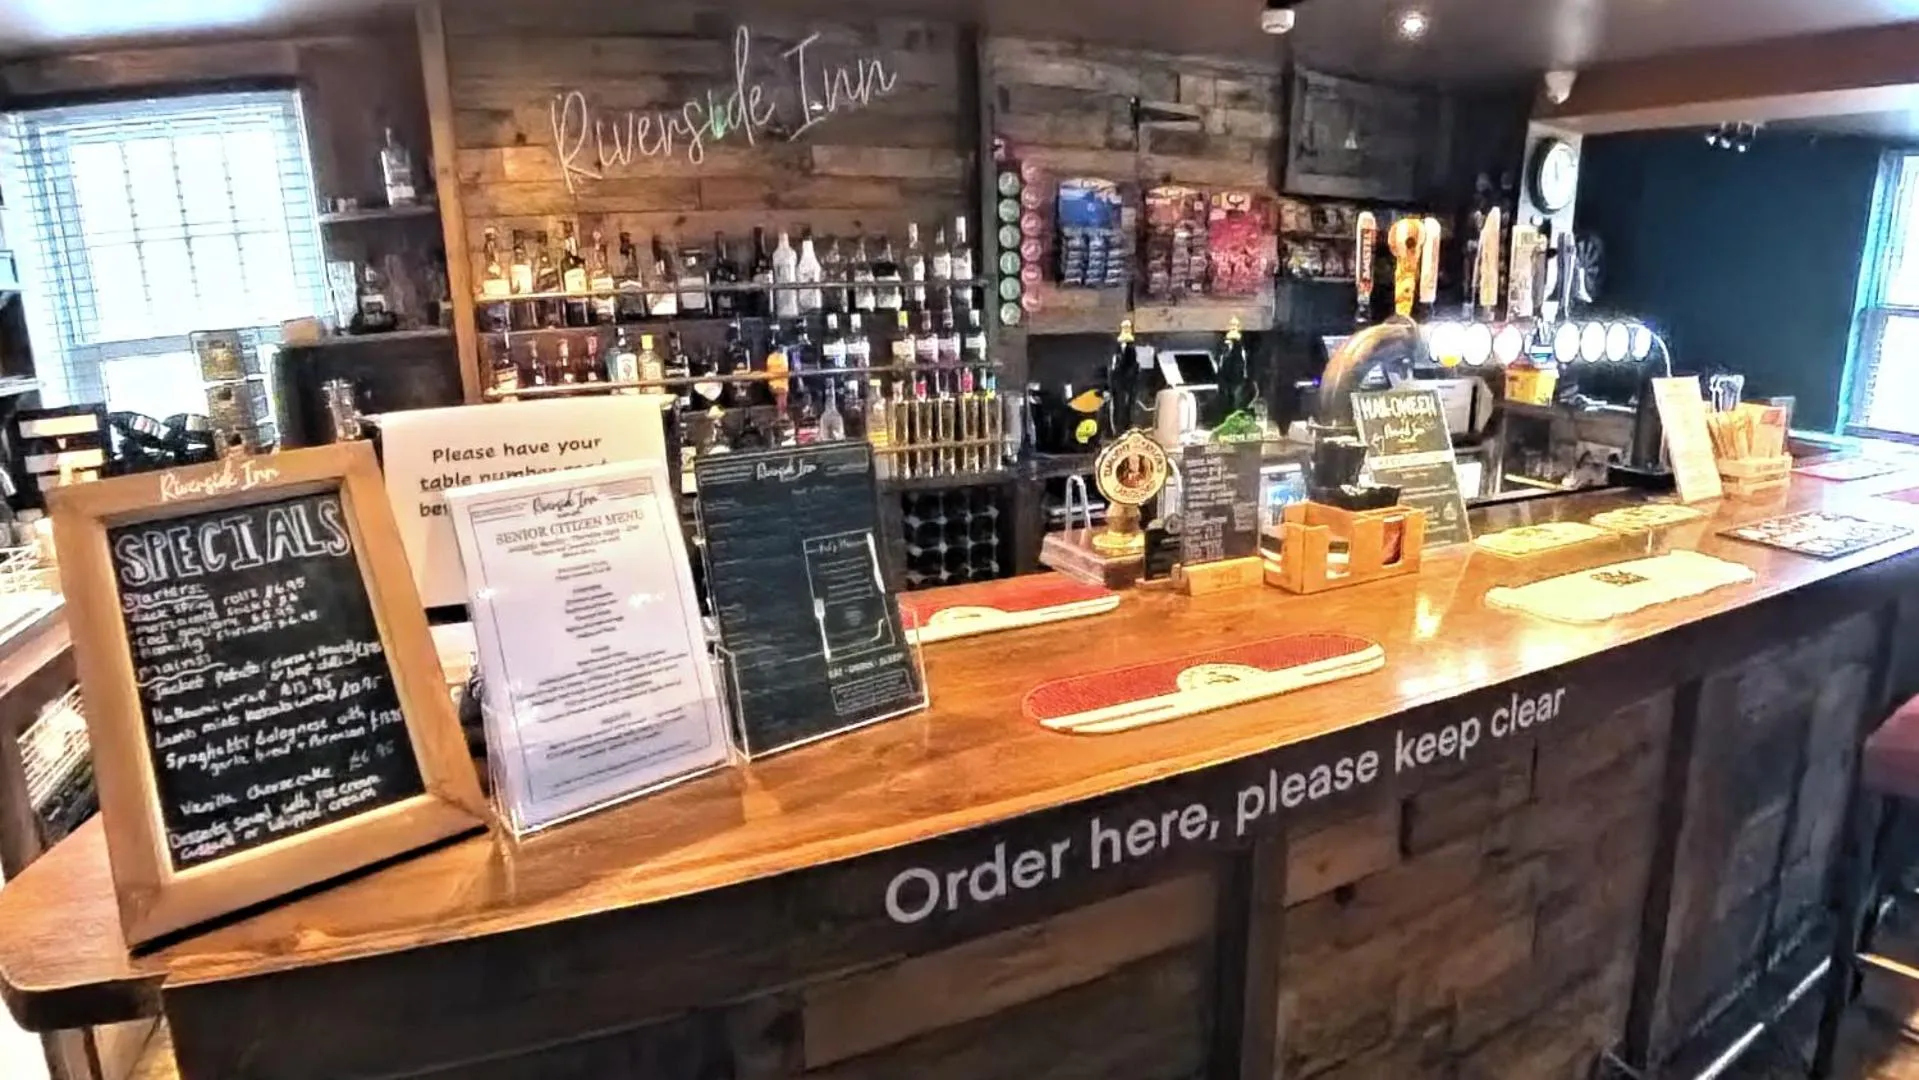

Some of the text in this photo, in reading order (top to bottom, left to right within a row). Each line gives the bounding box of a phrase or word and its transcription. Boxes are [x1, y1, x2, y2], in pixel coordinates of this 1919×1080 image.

[551, 25, 897, 194] Riverside Inn
[432, 437, 602, 464] Please have your
[240, 460, 280, 492] Inn
[420, 471, 472, 491] table
[115, 500, 350, 587] SPECIALS
[496, 524, 548, 546] SENIOR
[549, 515, 603, 539] CITIZEN
[604, 508, 644, 527] MENU
[885, 687, 1566, 924] Order here, please keep clear
